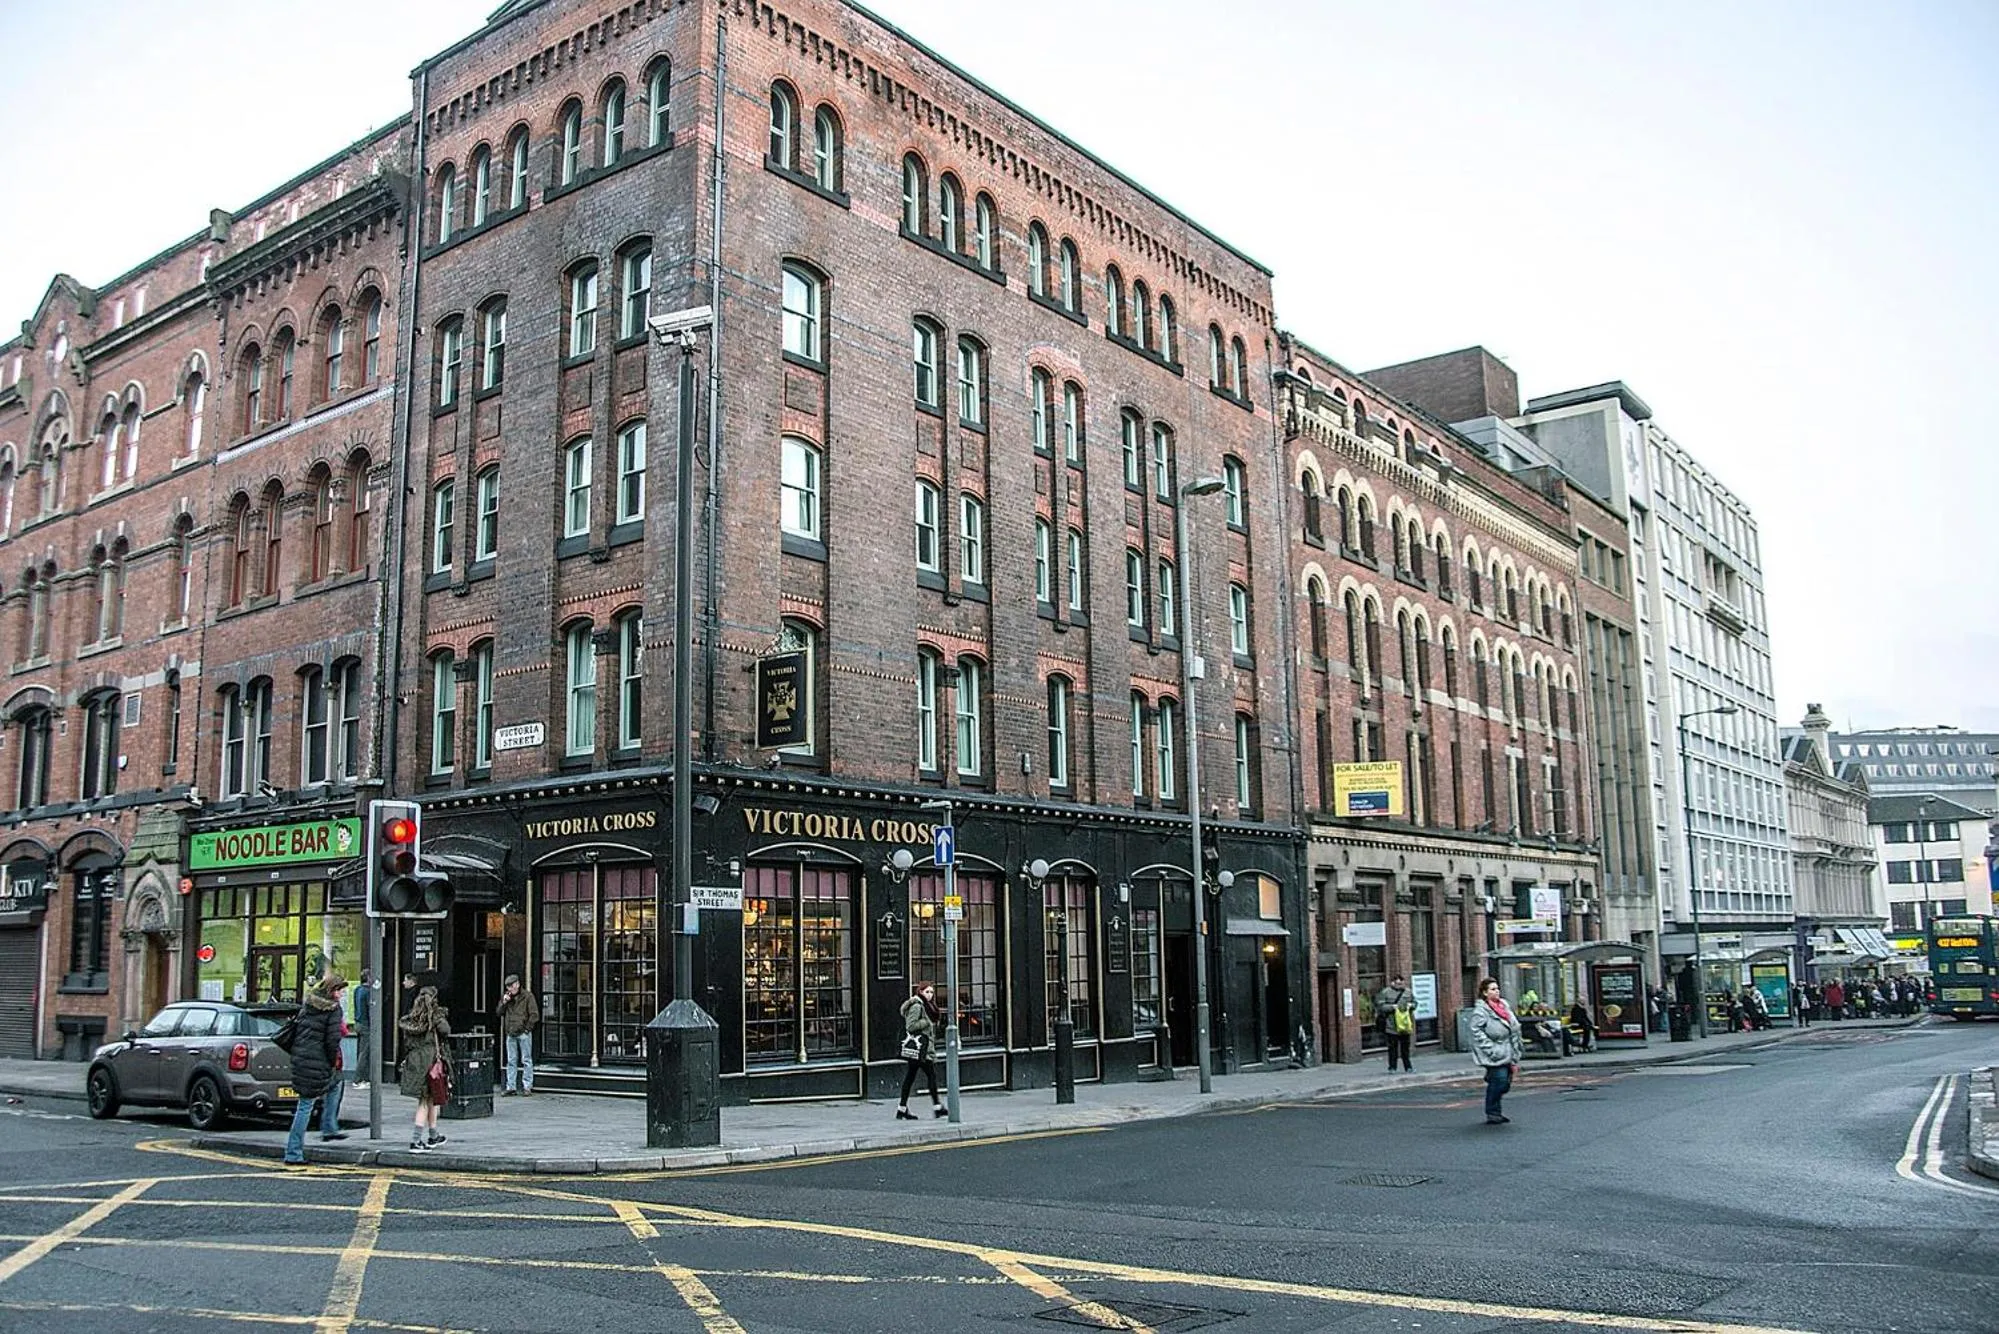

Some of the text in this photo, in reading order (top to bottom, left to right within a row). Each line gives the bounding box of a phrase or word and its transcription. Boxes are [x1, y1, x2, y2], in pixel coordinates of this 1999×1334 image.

[500, 725, 539, 737] VICTORIA
[503, 735, 535, 747] STREET
[1336, 764, 1351, 772] FOR
[526, 810, 657, 839] VICTORIA CROSS
[743, 808, 866, 841] VICTORIA
[215, 830, 287, 861] NOODLE
[291, 826, 330, 854] BAR
[708, 889, 739, 899] THOMAS
[697, 898, 724, 907] STREET
